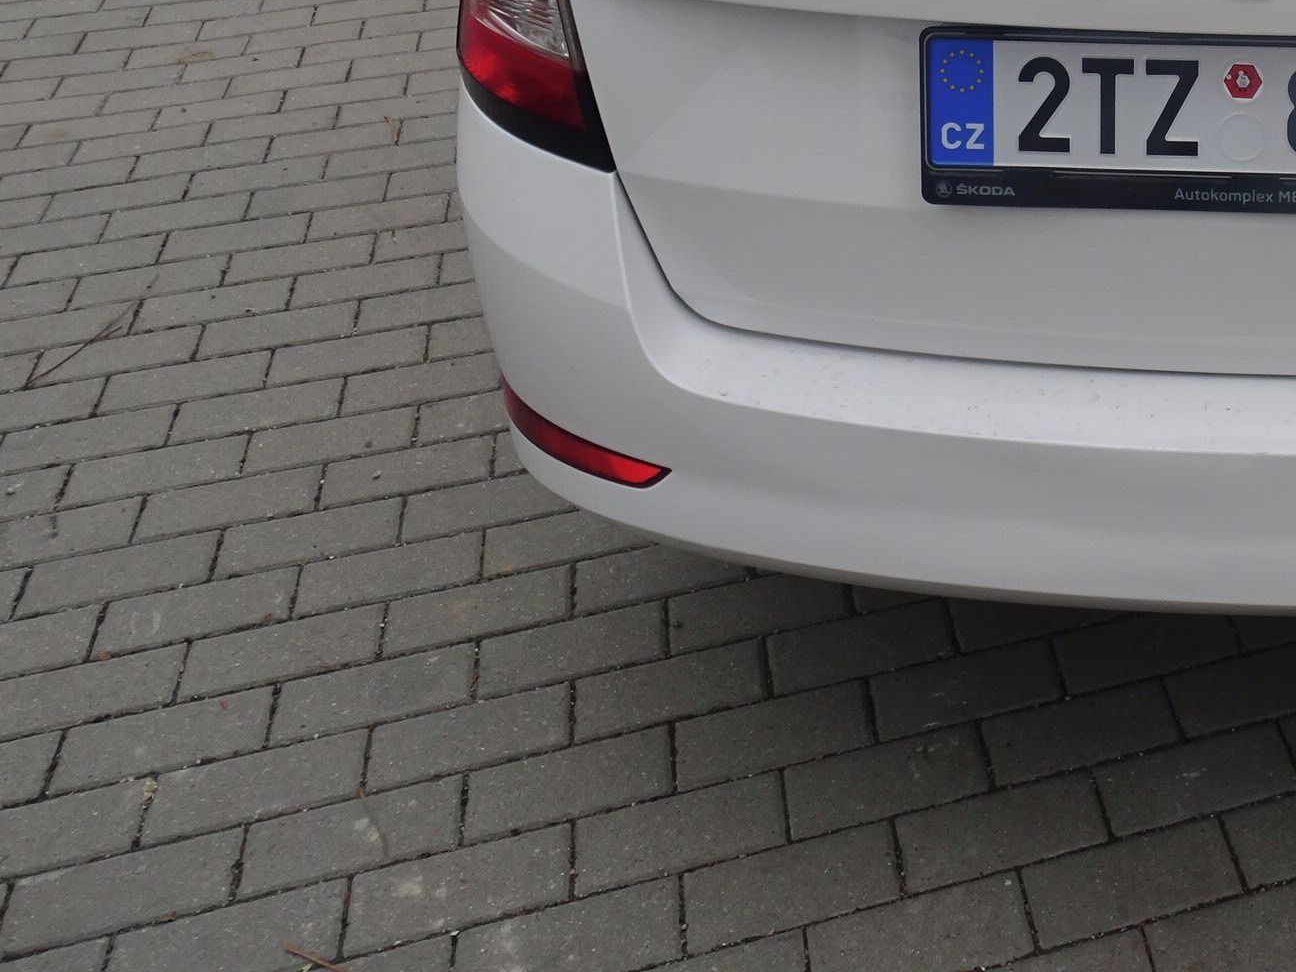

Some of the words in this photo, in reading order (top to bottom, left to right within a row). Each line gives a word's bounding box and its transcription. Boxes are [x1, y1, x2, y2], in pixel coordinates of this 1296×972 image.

[1018, 56, 1199, 157] 2TZ
[940, 122, 985, 151] CZ
[956, 183, 1015, 196] ŠKODA
[1174, 188, 1273, 205] Autokomplex
